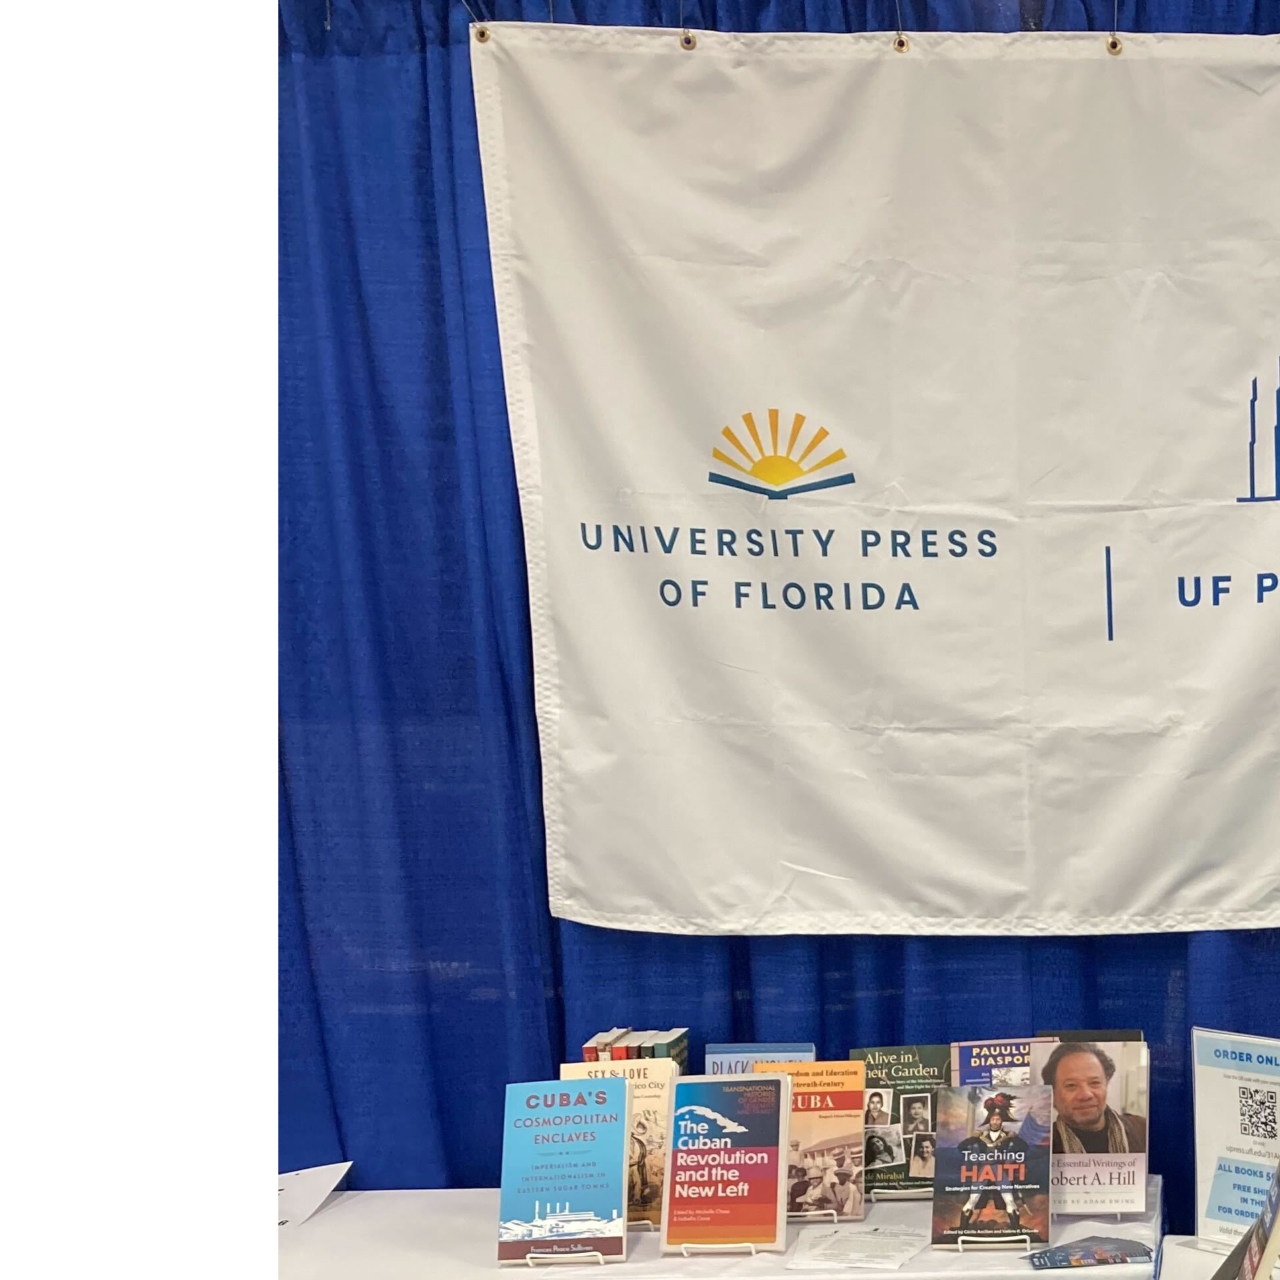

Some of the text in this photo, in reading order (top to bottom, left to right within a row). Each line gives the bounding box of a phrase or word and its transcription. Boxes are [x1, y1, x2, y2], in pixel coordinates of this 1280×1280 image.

[580, 522, 998, 559] UNIVERSITY PRESS
[659, 579, 920, 611] OF FLORIDA
[1177, 574, 1231, 608] UF
[865, 1052, 912, 1064] Alive in
[971, 1055, 1030, 1066] DIASPOR
[1214, 1049, 1253, 1063] ORDER
[623, 1068, 649, 1079] LOVE
[712, 1061, 749, 1075] BLACK
[891, 1064, 938, 1077] Garden
[648, 1082, 665, 1090] City
[526, 1091, 607, 1109] CUBA'S
[514, 1114, 618, 1129] COSMOPOLITAN
[678, 1121, 708, 1134] The
[534, 1132, 596, 1144] ENCLAVES
[678, 1137, 731, 1150] Cuban
[677, 1150, 768, 1166] Revolution
[962, 1150, 1025, 1163] Teaching
[1057, 1158, 1136, 1169] Essential Writings of
[522, 1173, 594, 1182] INTERNATIONALISM
[675, 1167, 739, 1181] and the
[960, 1164, 1026, 1183] HAITI
[1218, 1164, 1263, 1178] ALL BOOKS
[1091, 1171, 1136, 1185] A. Hill
[675, 1182, 749, 1197] New Left
[1233, 1184, 1251, 1193] FREE
[1240, 1197, 1264, 1207] IN THE
[1218, 1206, 1232, 1214] FOR
